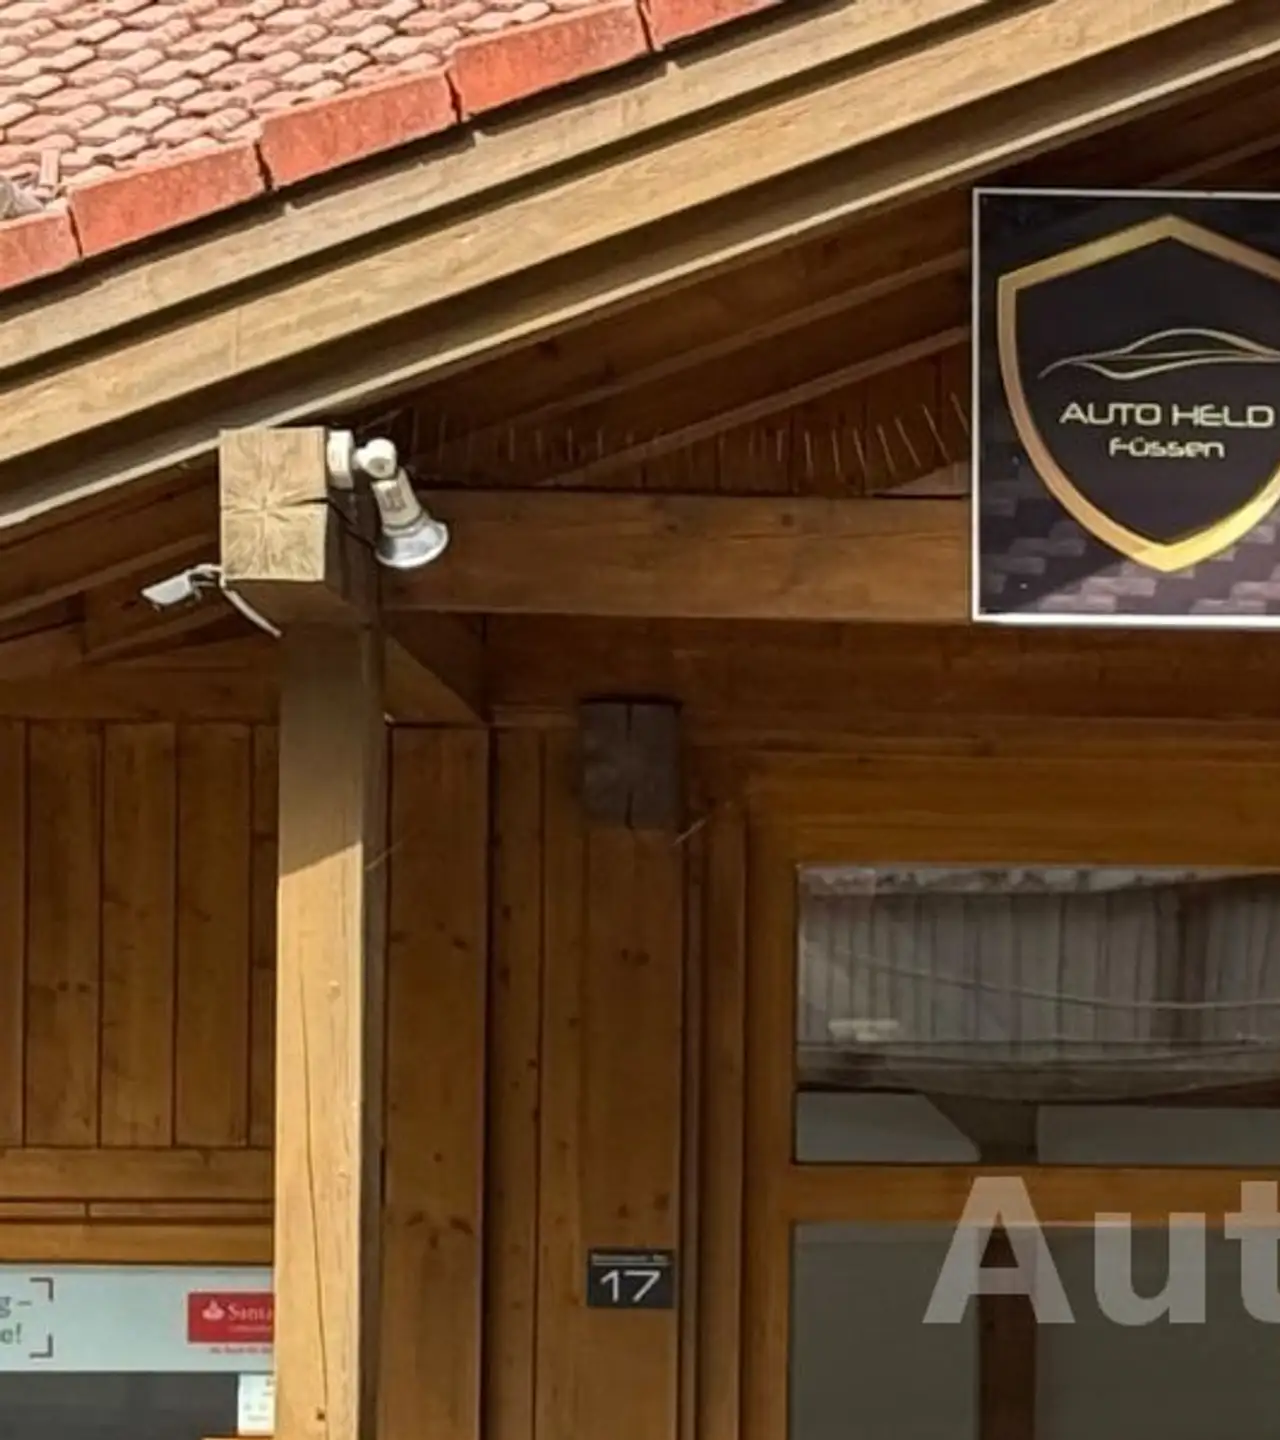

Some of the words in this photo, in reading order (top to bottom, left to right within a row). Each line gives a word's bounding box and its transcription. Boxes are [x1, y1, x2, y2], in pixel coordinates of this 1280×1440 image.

[1059, 401, 1162, 427] AUTO
[1170, 403, 1275, 429] HELD
[600, 1269, 661, 1303] 17
